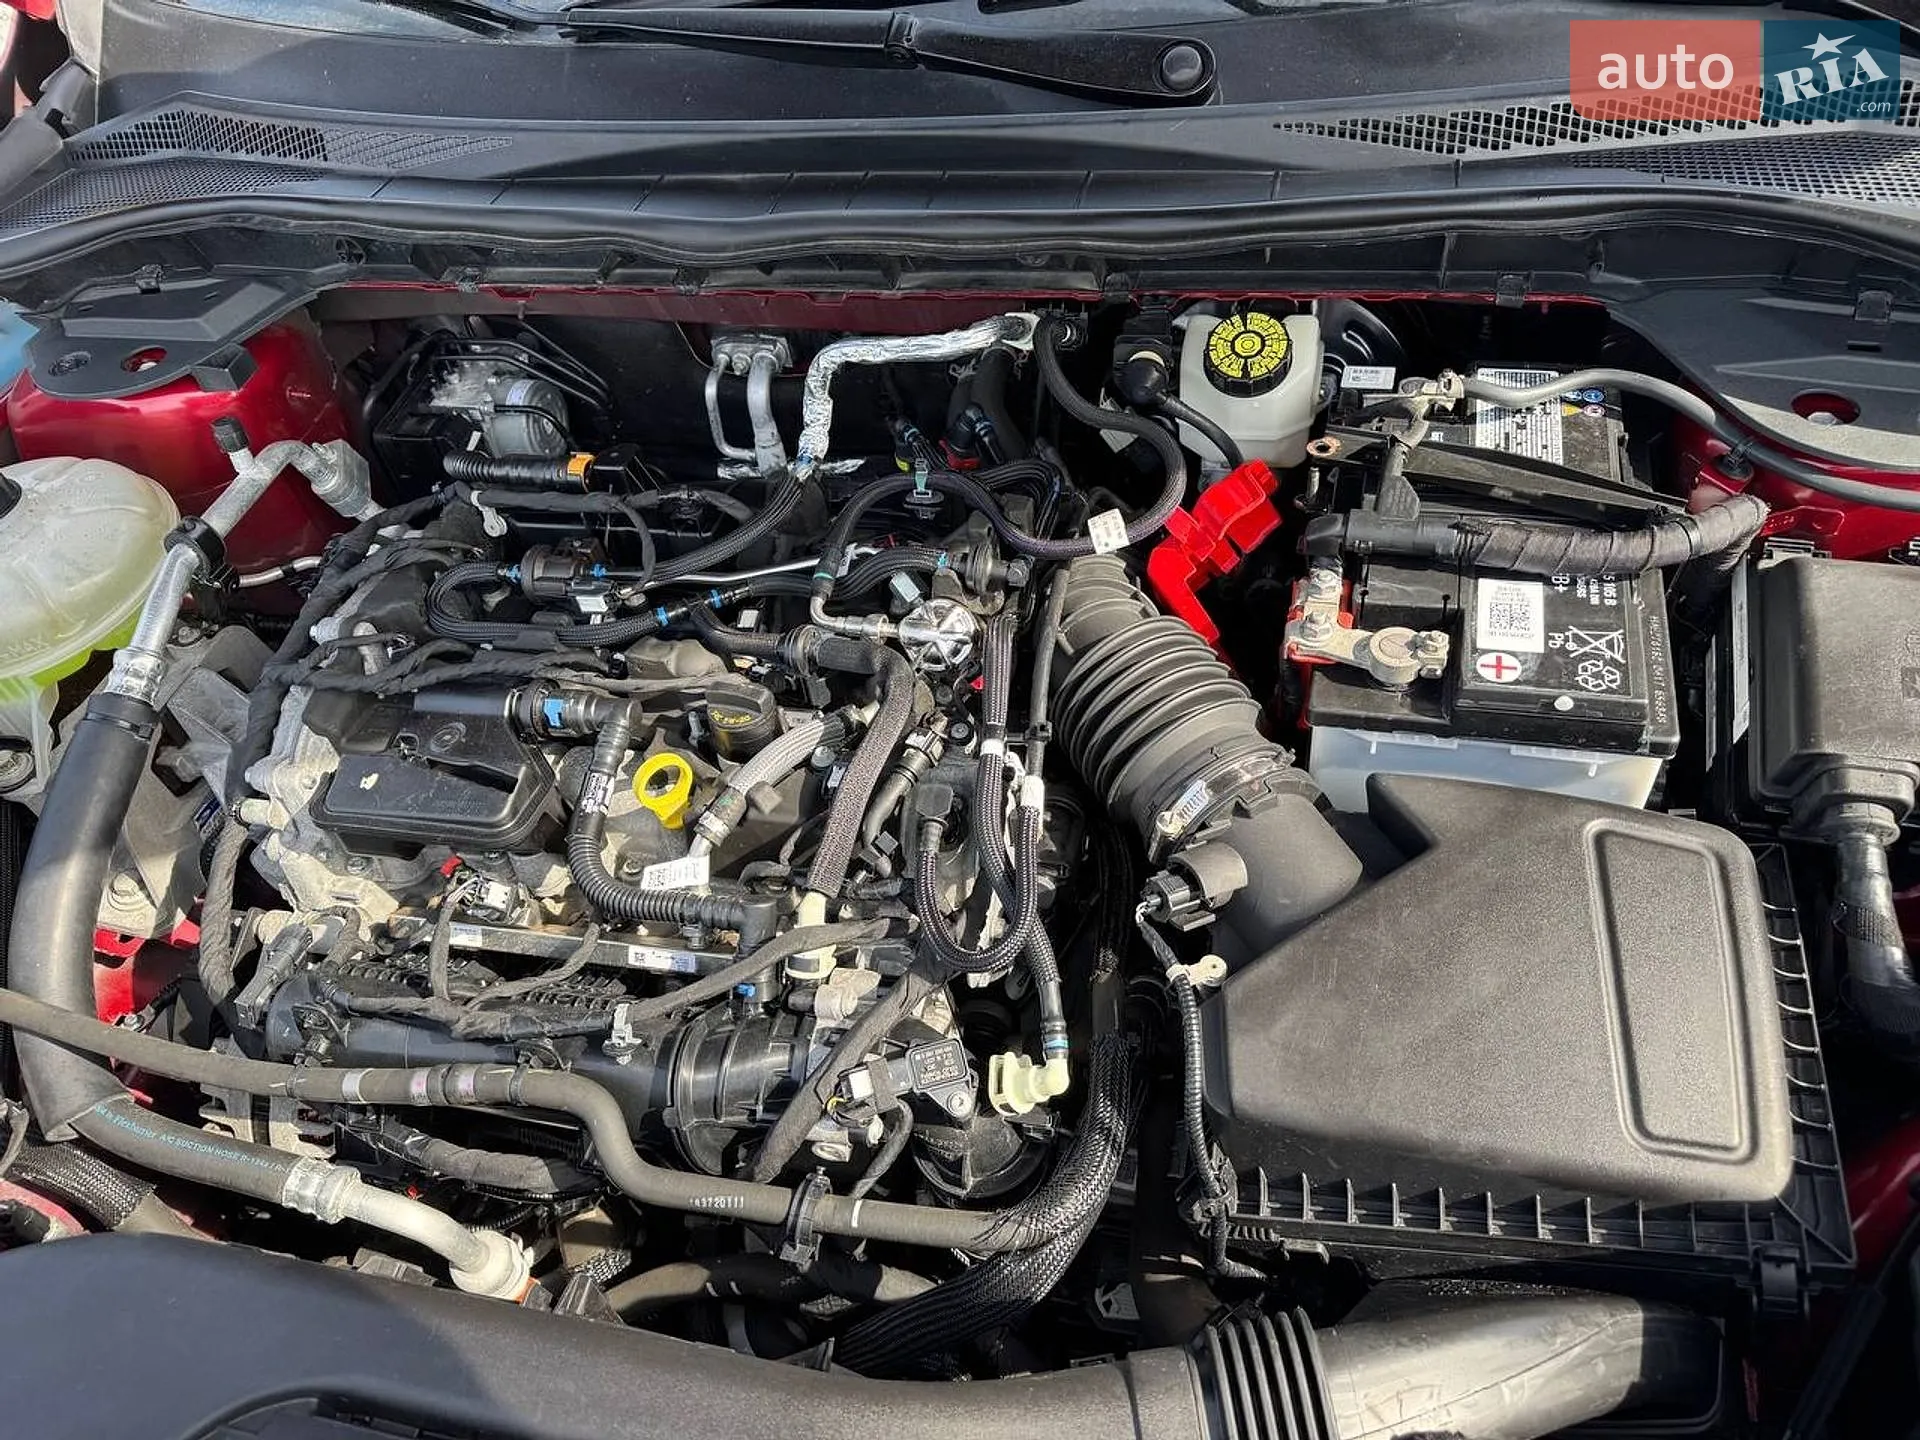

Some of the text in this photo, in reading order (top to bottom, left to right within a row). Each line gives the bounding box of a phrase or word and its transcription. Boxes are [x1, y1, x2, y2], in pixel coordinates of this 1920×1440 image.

[1548, 632, 1564, 648] Pb
[175, 1137, 216, 1155] SUCTION
[215, 1147, 239, 1160] HOSE
